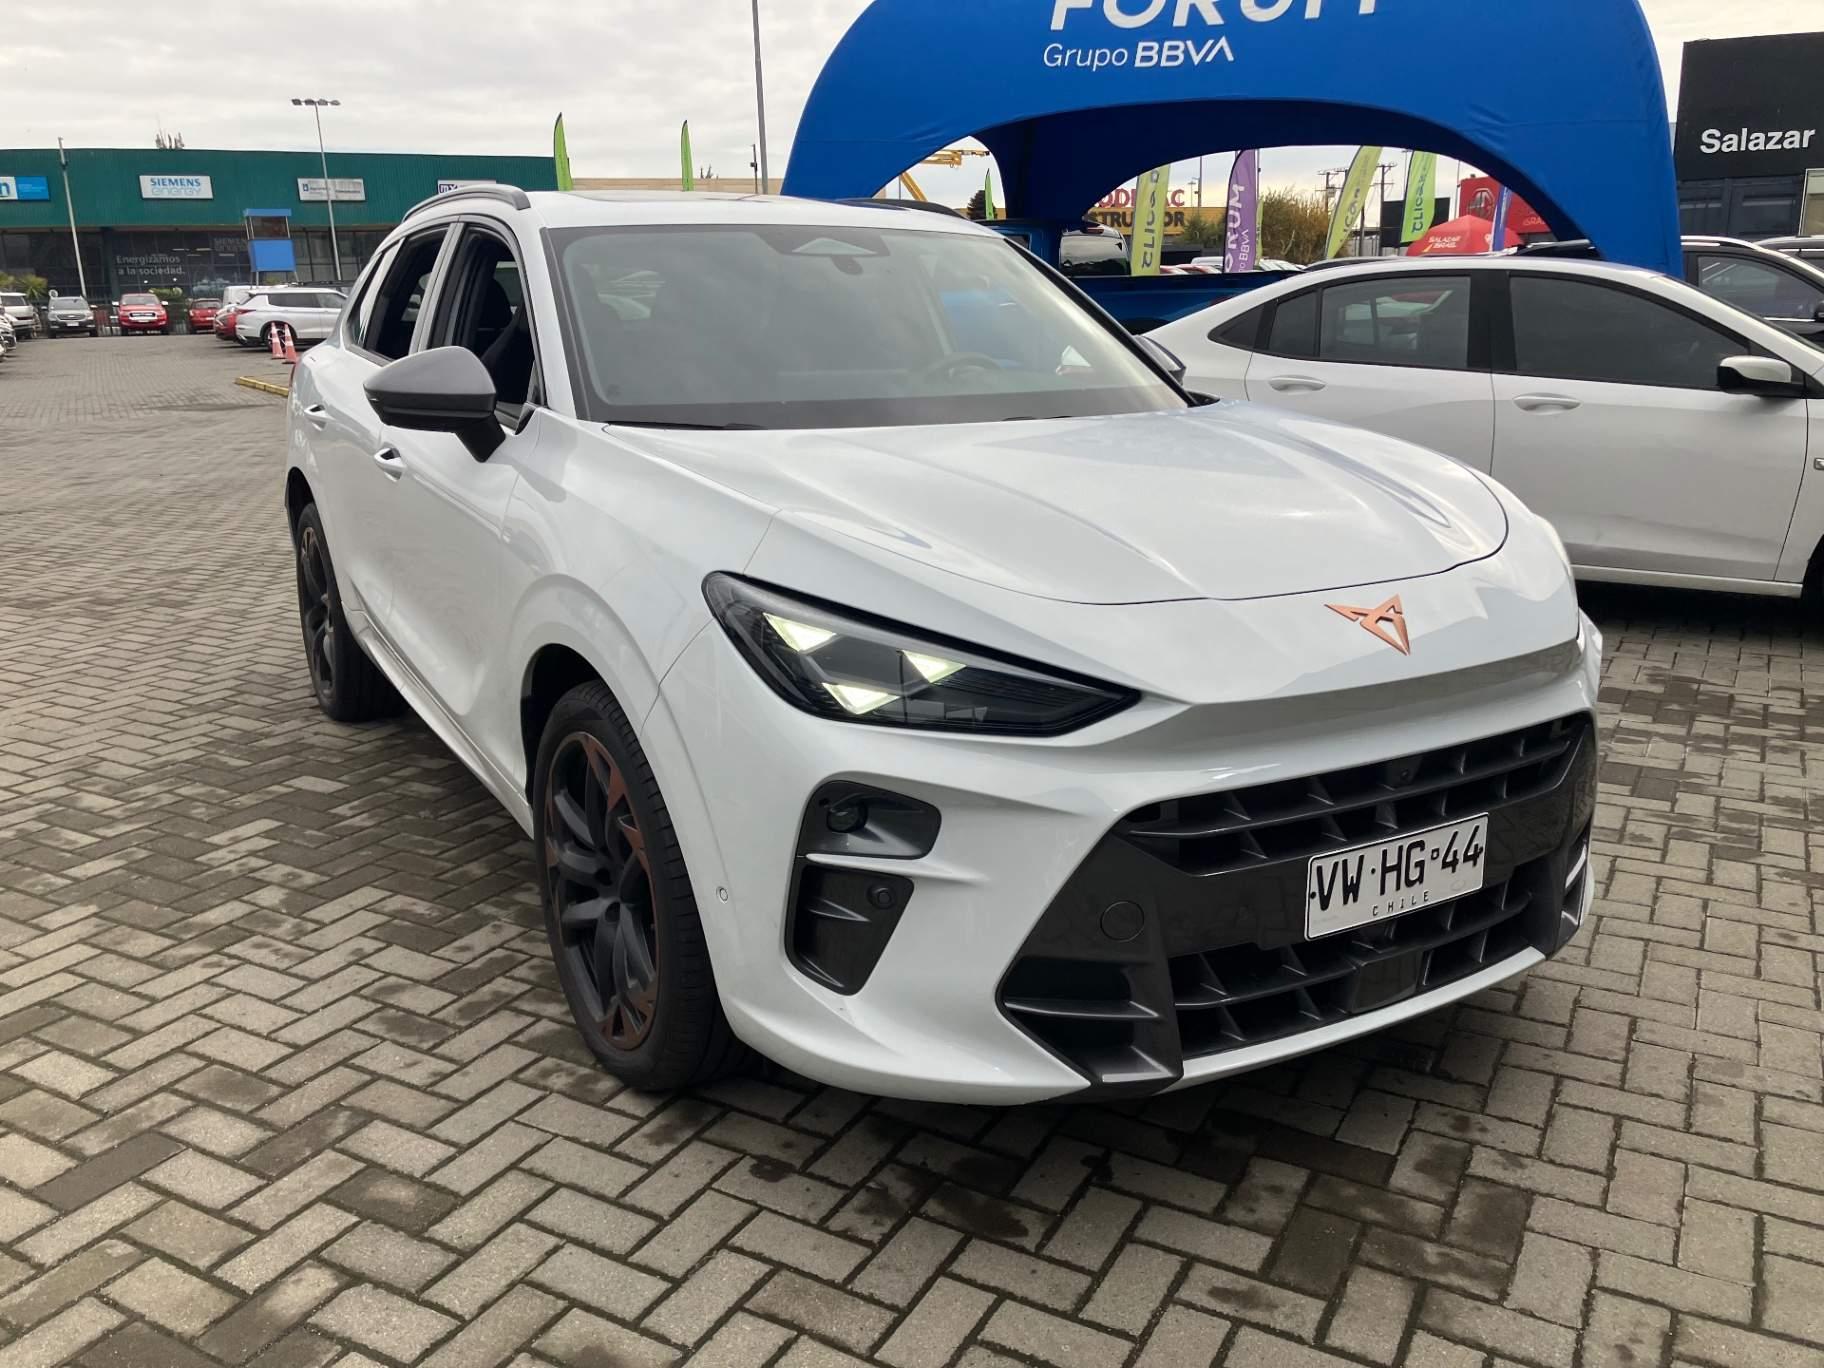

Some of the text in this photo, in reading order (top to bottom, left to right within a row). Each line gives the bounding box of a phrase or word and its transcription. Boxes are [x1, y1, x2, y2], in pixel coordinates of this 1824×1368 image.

[1043, 35, 1235, 72] Grupo BBVA
[1700, 128, 1816, 154] Salazar
[150, 177, 201, 187] SIEMENS
[127, 266, 136, 275] la
[1372, 890, 1429, 917] CHILE
